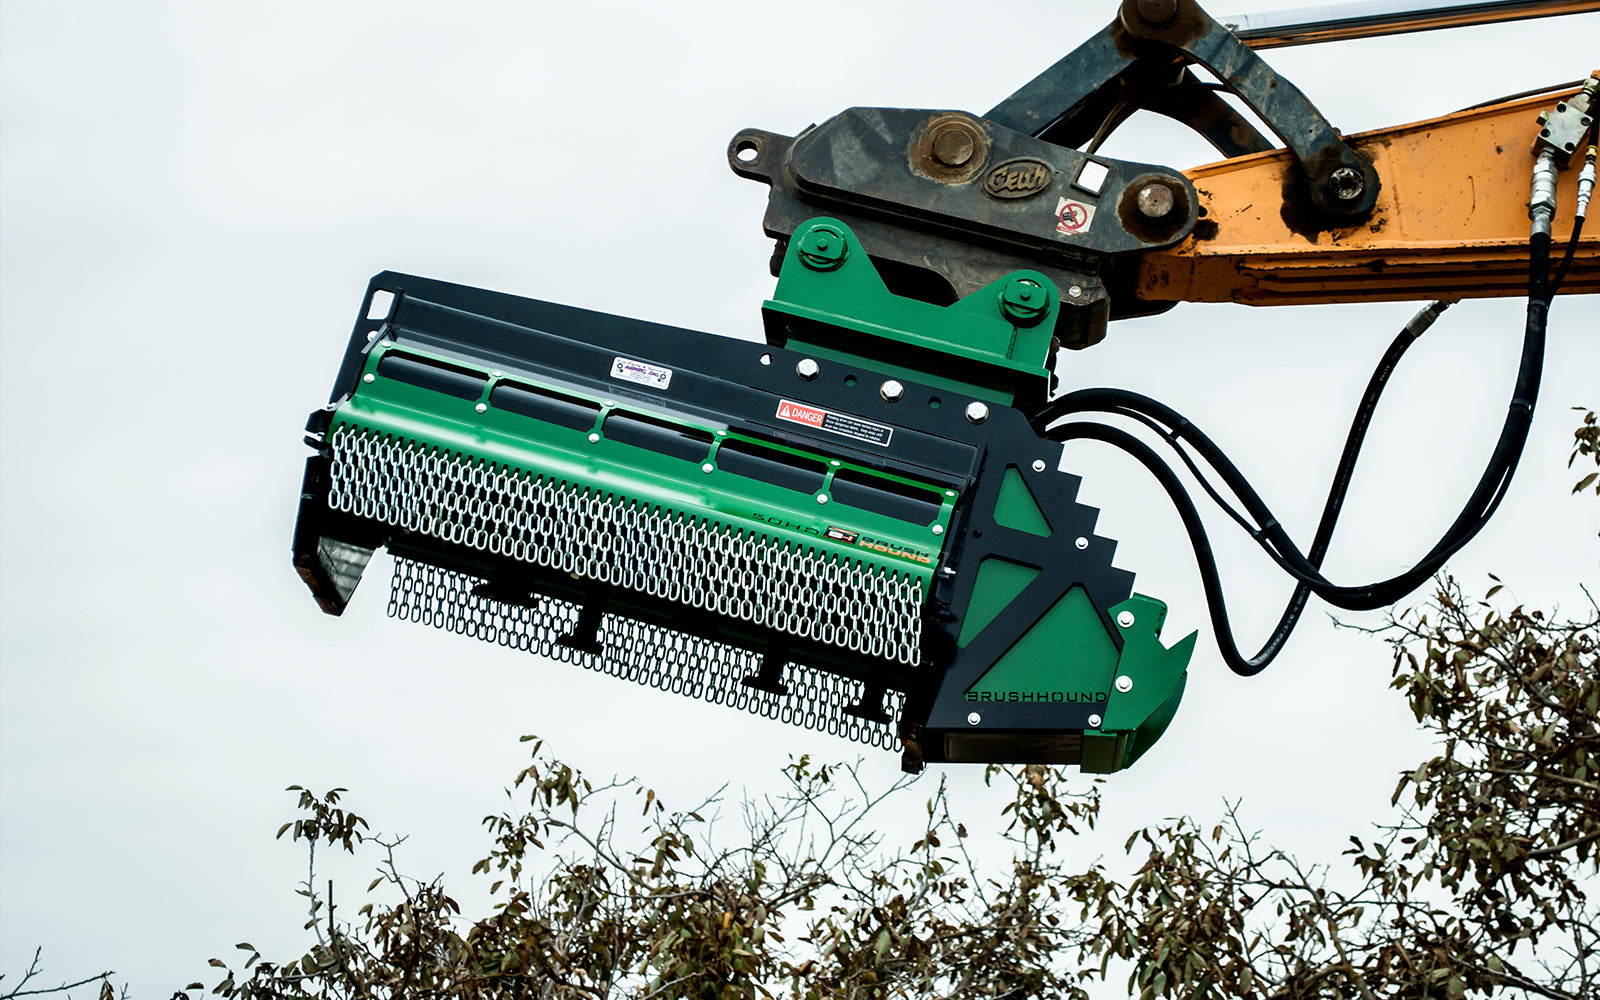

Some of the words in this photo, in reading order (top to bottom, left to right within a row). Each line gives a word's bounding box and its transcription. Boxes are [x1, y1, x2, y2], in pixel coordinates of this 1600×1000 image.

[791, 407, 823, 424] DANGER
[858, 540, 931, 564] HOUND
[861, 536, 930, 558] BRUSH
[967, 691, 1108, 702] BRUSHHOUND
